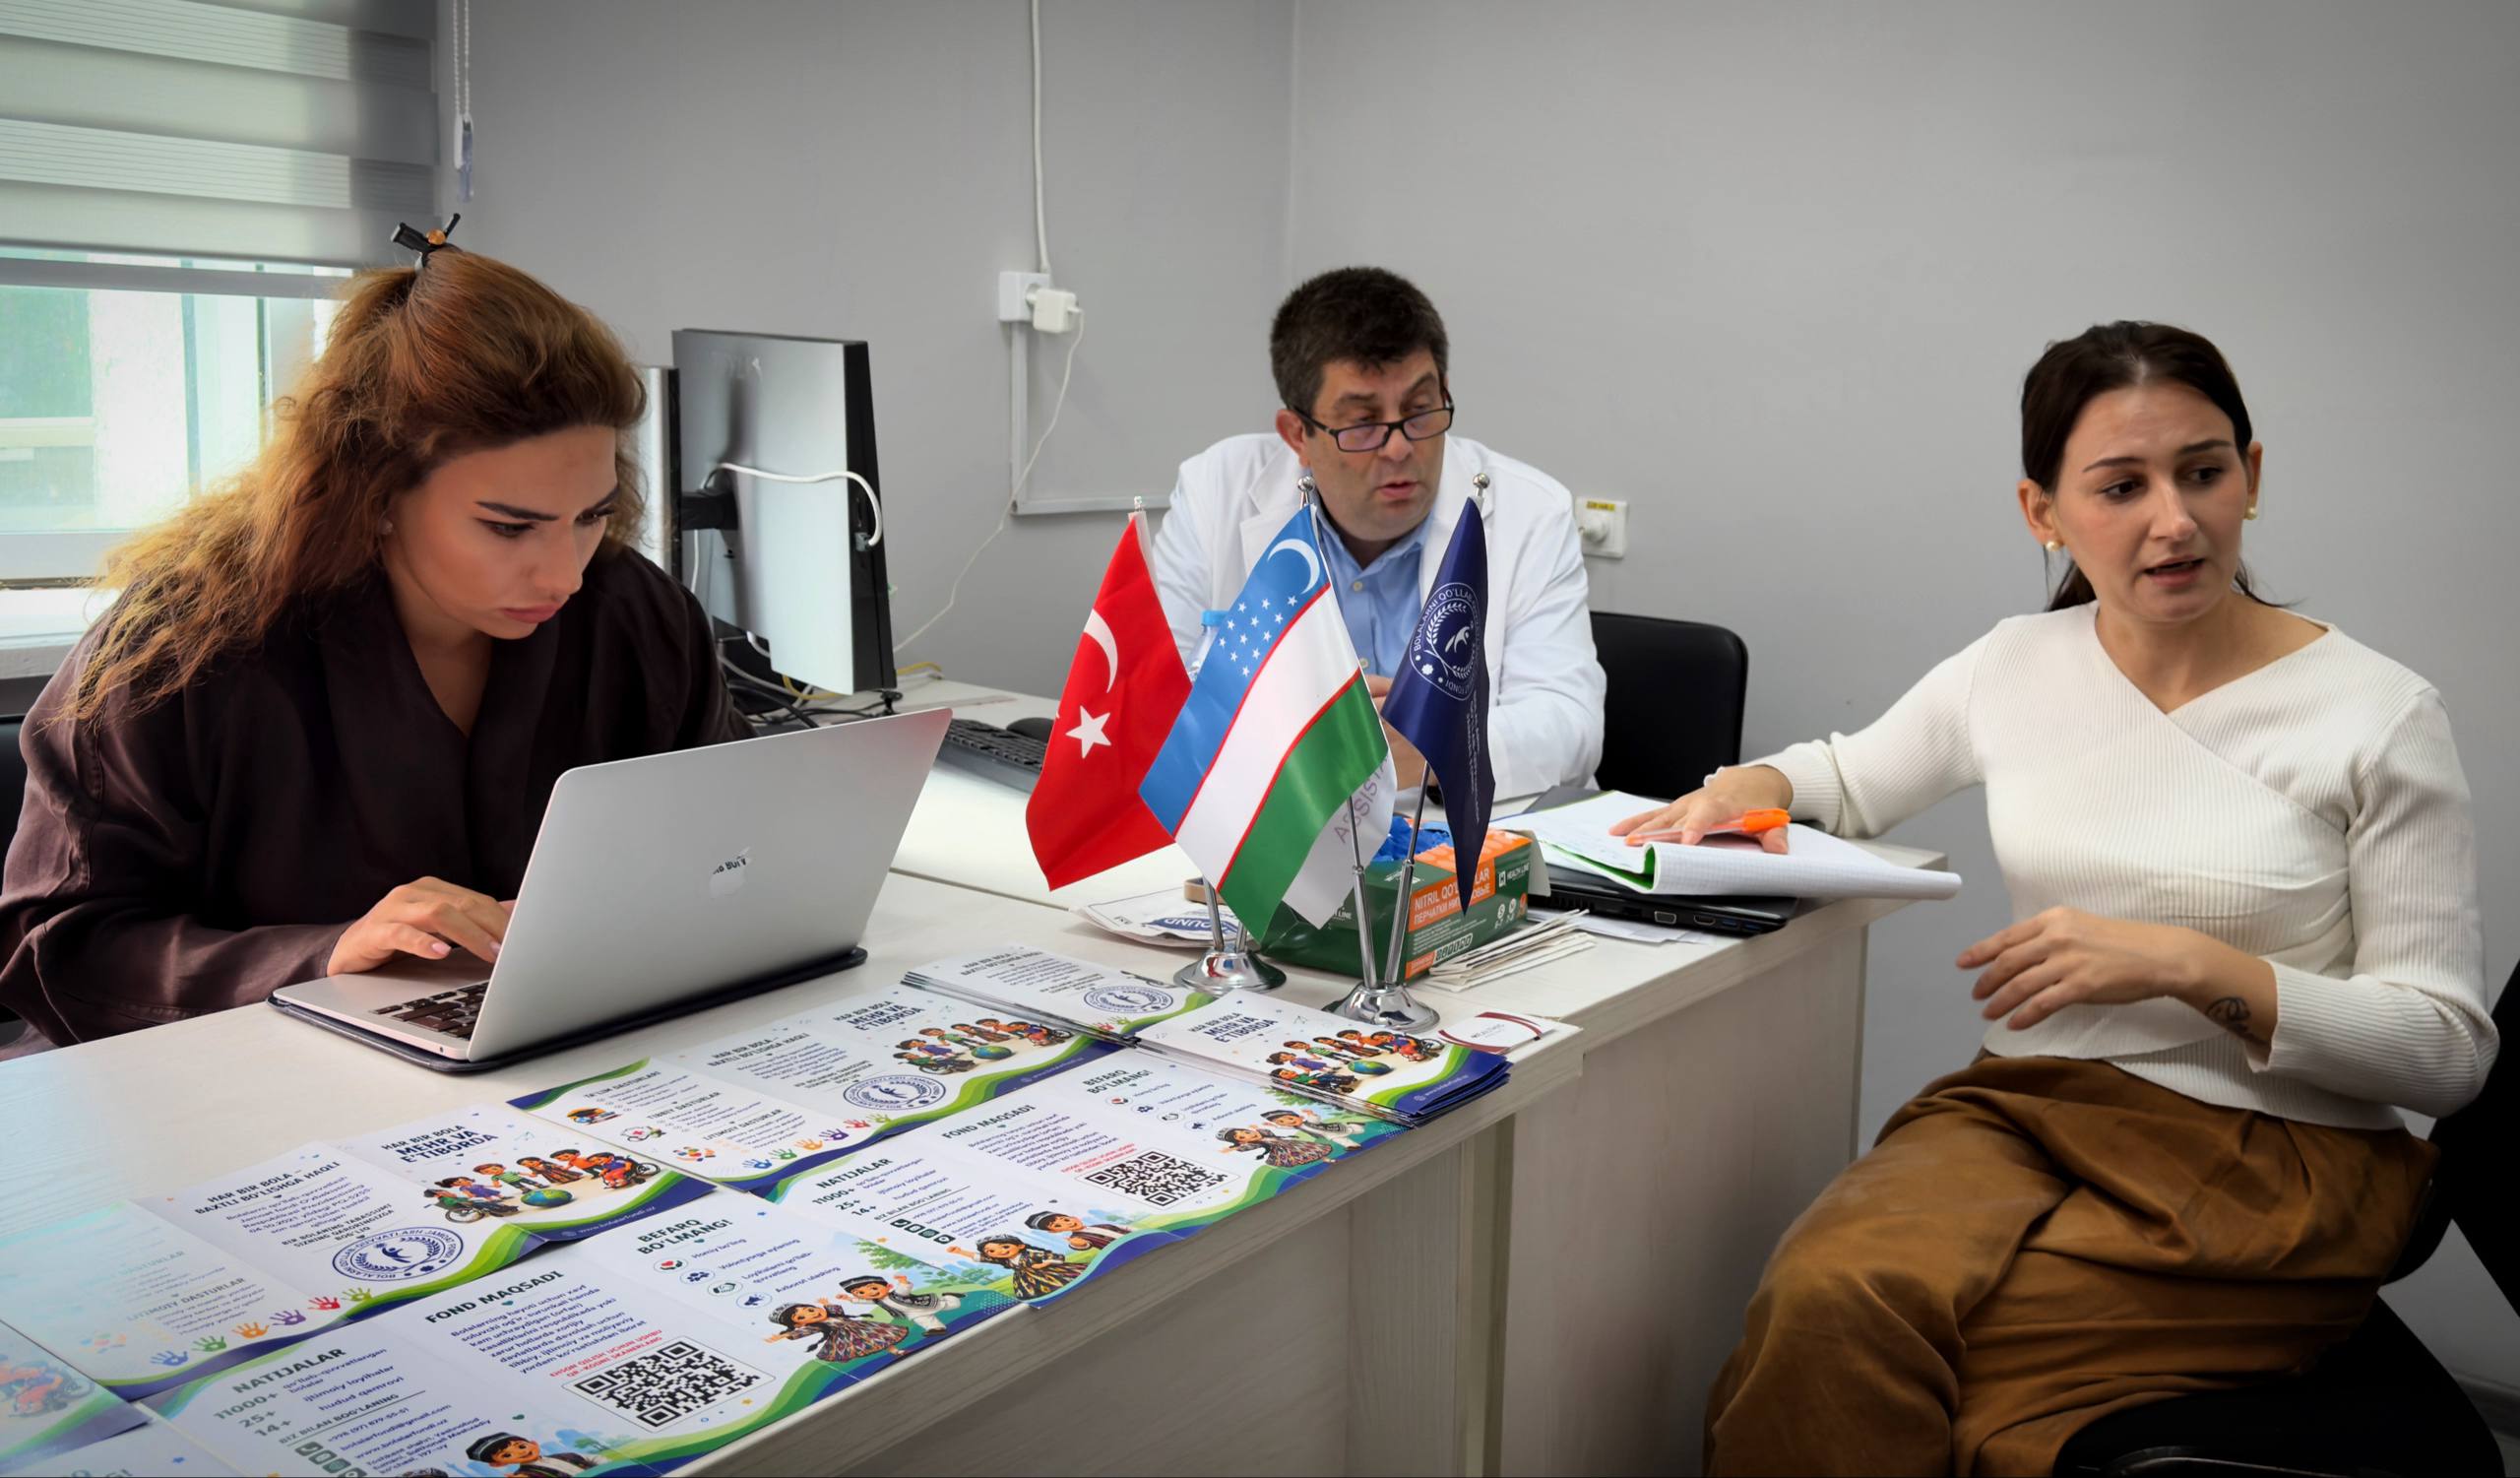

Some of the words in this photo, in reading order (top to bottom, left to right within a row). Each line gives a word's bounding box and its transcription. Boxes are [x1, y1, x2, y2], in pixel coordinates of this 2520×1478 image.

[1416, 887, 1439, 909] NITRIL
[847, 1011, 889, 1025] MEHR
[868, 1000, 893, 1010] BOLA
[852, 1007, 924, 1031] E'TIBORDA
[1203, 1022, 1243, 1036] MEHR
[1083, 1070, 1128, 1086] BEFARQ
[942, 1125, 978, 1138] FOND
[976, 1105, 1036, 1127] MAQSADI
[381, 1141, 409, 1150] HAR
[410, 1134, 432, 1143] BIR
[432, 1125, 465, 1136] BOLA
[396, 1138, 452, 1155] MEHR
[450, 1130, 478, 1139] VA
[401, 1133, 498, 1163] E'TIBORDA
[816, 1159, 893, 1189] NATIJALAR
[194, 1196, 239, 1214] BAXTLI
[240, 1178, 304, 1201] BO'LISHGA
[303, 1162, 340, 1179] HAQLI
[208, 1192, 235, 1202] HAR
[235, 1186, 259, 1194] BIR
[260, 1174, 292, 1187] BOLA
[812, 1189, 854, 1204] 11000+
[835, 1200, 860, 1210] 25+
[851, 1206, 876, 1216] 14+
[637, 1219, 701, 1244] BEFARQ
[637, 1219, 732, 1254] BO'LMANG!
[180, 1278, 245, 1304] DASTURLAR
[425, 1302, 476, 1323] FOND
[477, 1271, 564, 1304] MAQSADI
[451, 1315, 508, 1337] Bolalarning
[506, 1304, 537, 1316] hayoti
[537, 1293, 566, 1306] uchun
[567, 1284, 587, 1295] xavf
[462, 1324, 500, 1342] soluvchi
[568, 1289, 600, 1302] hamda
[539, 1307, 597, 1330] respublikada
[597, 1298, 616, 1308] yoki
[470, 1337, 492, 1347] kam
[493, 1316, 550, 1338] uchraydigan
[491, 1346, 515, 1358] zarur
[515, 1331, 555, 1347] hollarda
[500, 1340, 554, 1363] davlatlarda
[555, 1323, 597, 1341] davolash
[597, 1312, 625, 1324] uchun
[520, 1357, 557, 1374] yordam
[617, 1320, 647, 1333] iborat
[232, 1349, 346, 1393] NATIJALAR
[214, 1393, 278, 1419] 11000+
[239, 1411, 276, 1428] 25+
[346, 1366, 394, 1385] loyihalar
[254, 1421, 291, 1437] 14+
[318, 1394, 356, 1411] hudud
[358, 1377, 404, 1396] qamrovi
[279, 1434, 297, 1444] BIZ
[299, 1419, 333, 1435] BILAN
